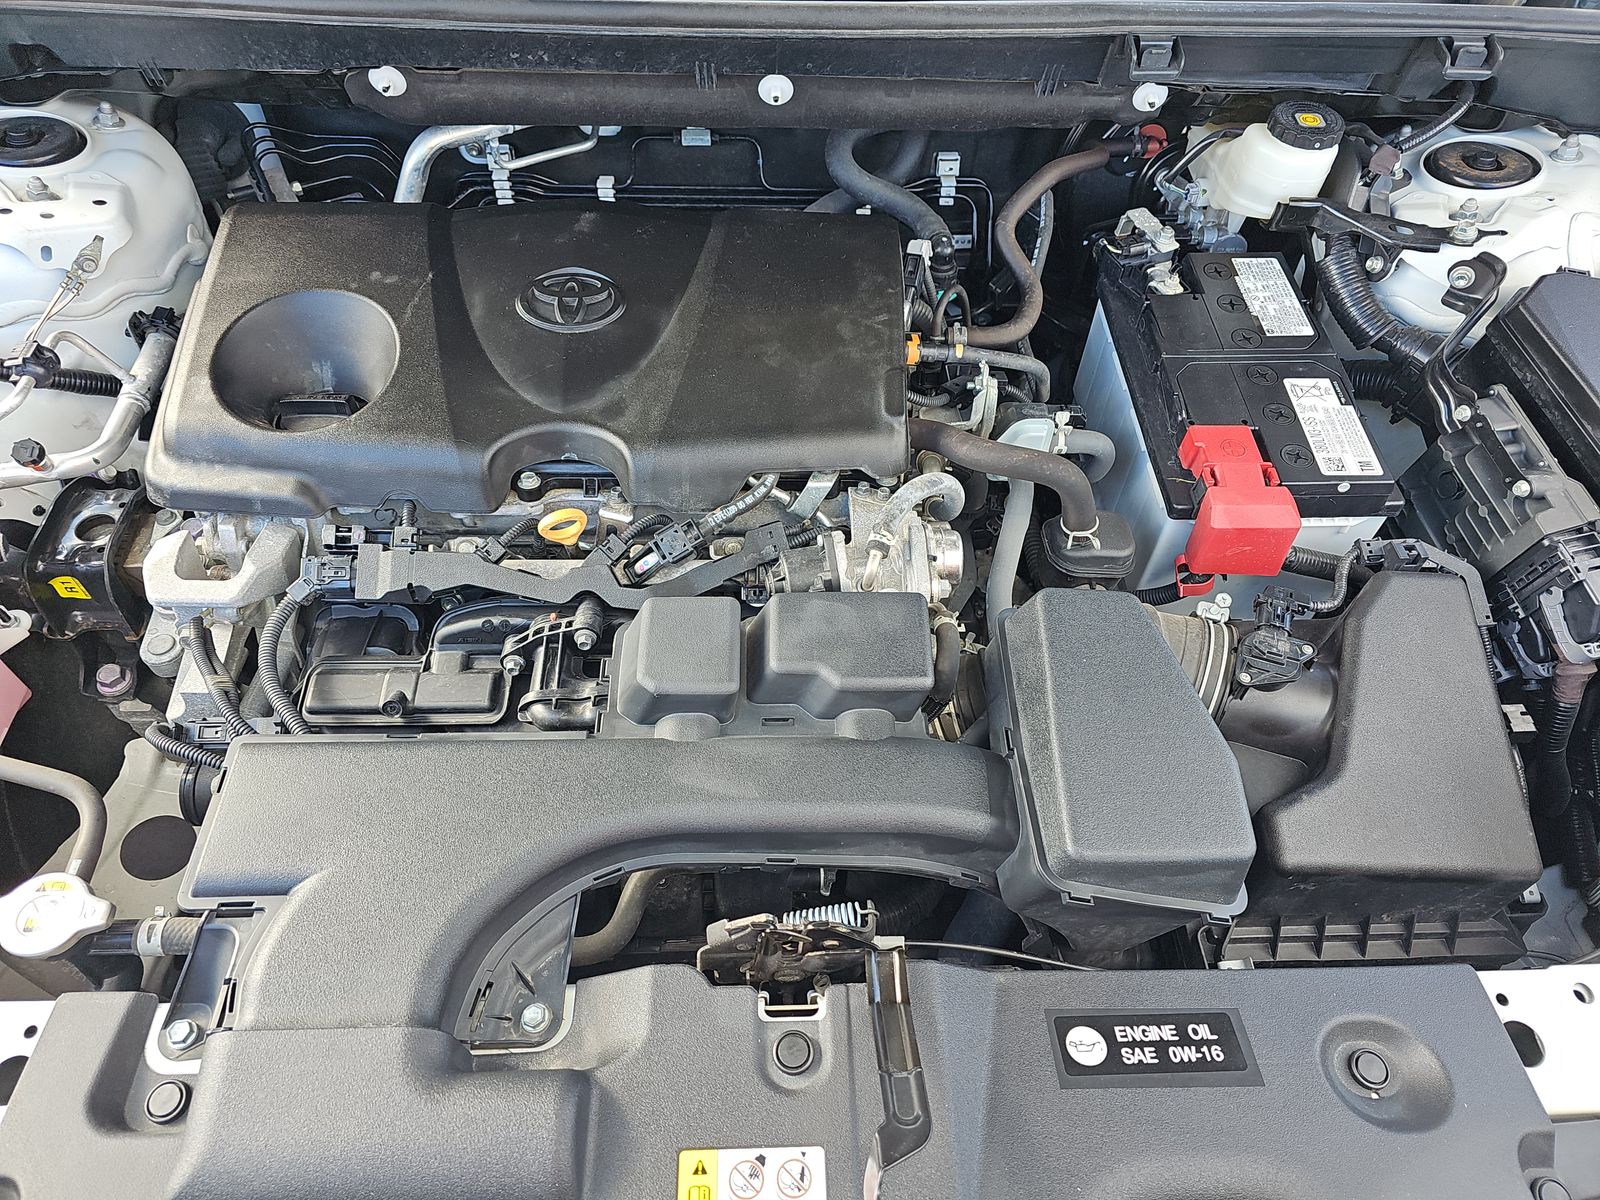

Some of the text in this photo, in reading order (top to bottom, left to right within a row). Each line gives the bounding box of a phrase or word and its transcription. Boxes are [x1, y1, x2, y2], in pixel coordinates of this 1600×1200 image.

[60, 581, 79, 593] R1
[1113, 1024, 1218, 1042] ENGINE OIL
[1121, 1045, 1225, 1064] SAE 0W-16
